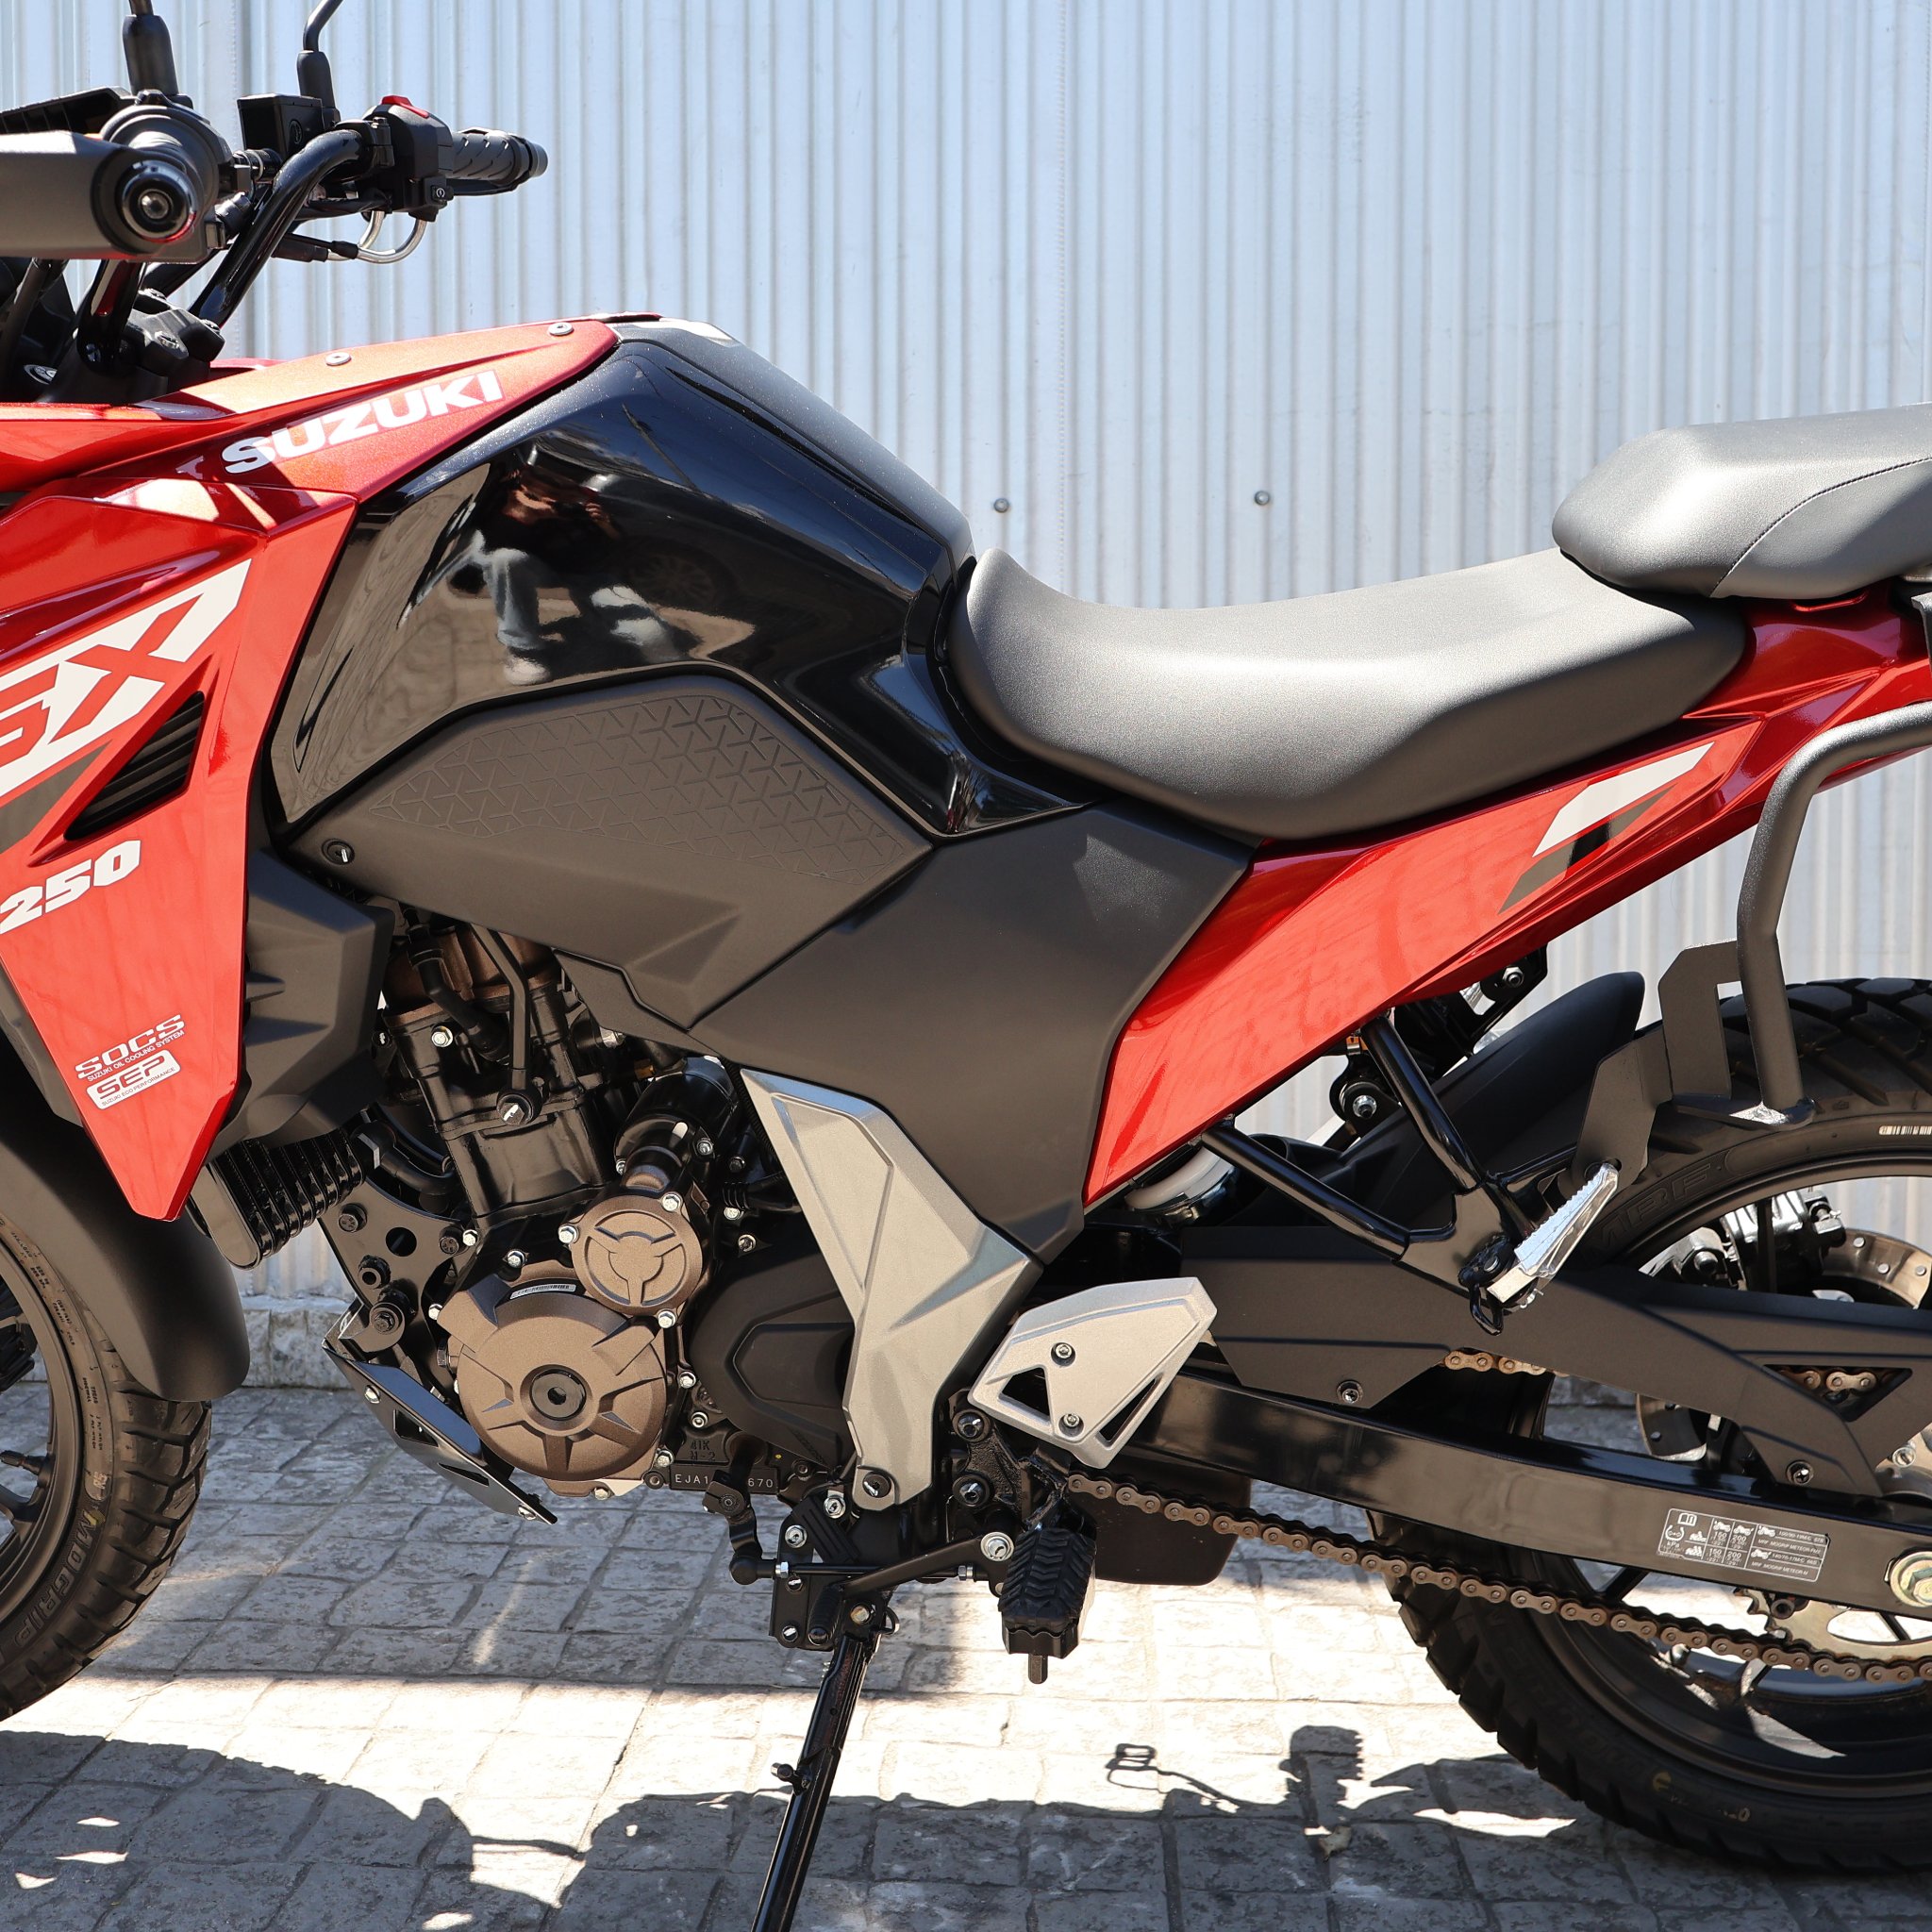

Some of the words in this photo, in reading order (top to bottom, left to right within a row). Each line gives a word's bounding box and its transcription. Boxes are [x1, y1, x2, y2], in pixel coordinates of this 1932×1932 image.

[221, 369, 504, 474] SUZUKI
[0, 840, 141, 934] 250
[75, 1014, 185, 1079] SOCS
[87, 1066, 112, 1082] SUZUKI
[113, 1060, 125, 1070] OIL
[125, 1045, 156, 1063] COOLING
[156, 1029, 185, 1048] SYSTEM
[96, 1055, 165, 1100] SEP
[102, 1094, 122, 1107] SUZUKI
[122, 1088, 134, 1096] ECO
[133, 1067, 175, 1091] PERFORMANCE
[675, 1474, 708, 1485] EJA1
[747, 1477, 774, 1488] 670
[14, 1508, 97, 1647] MOGRIP
